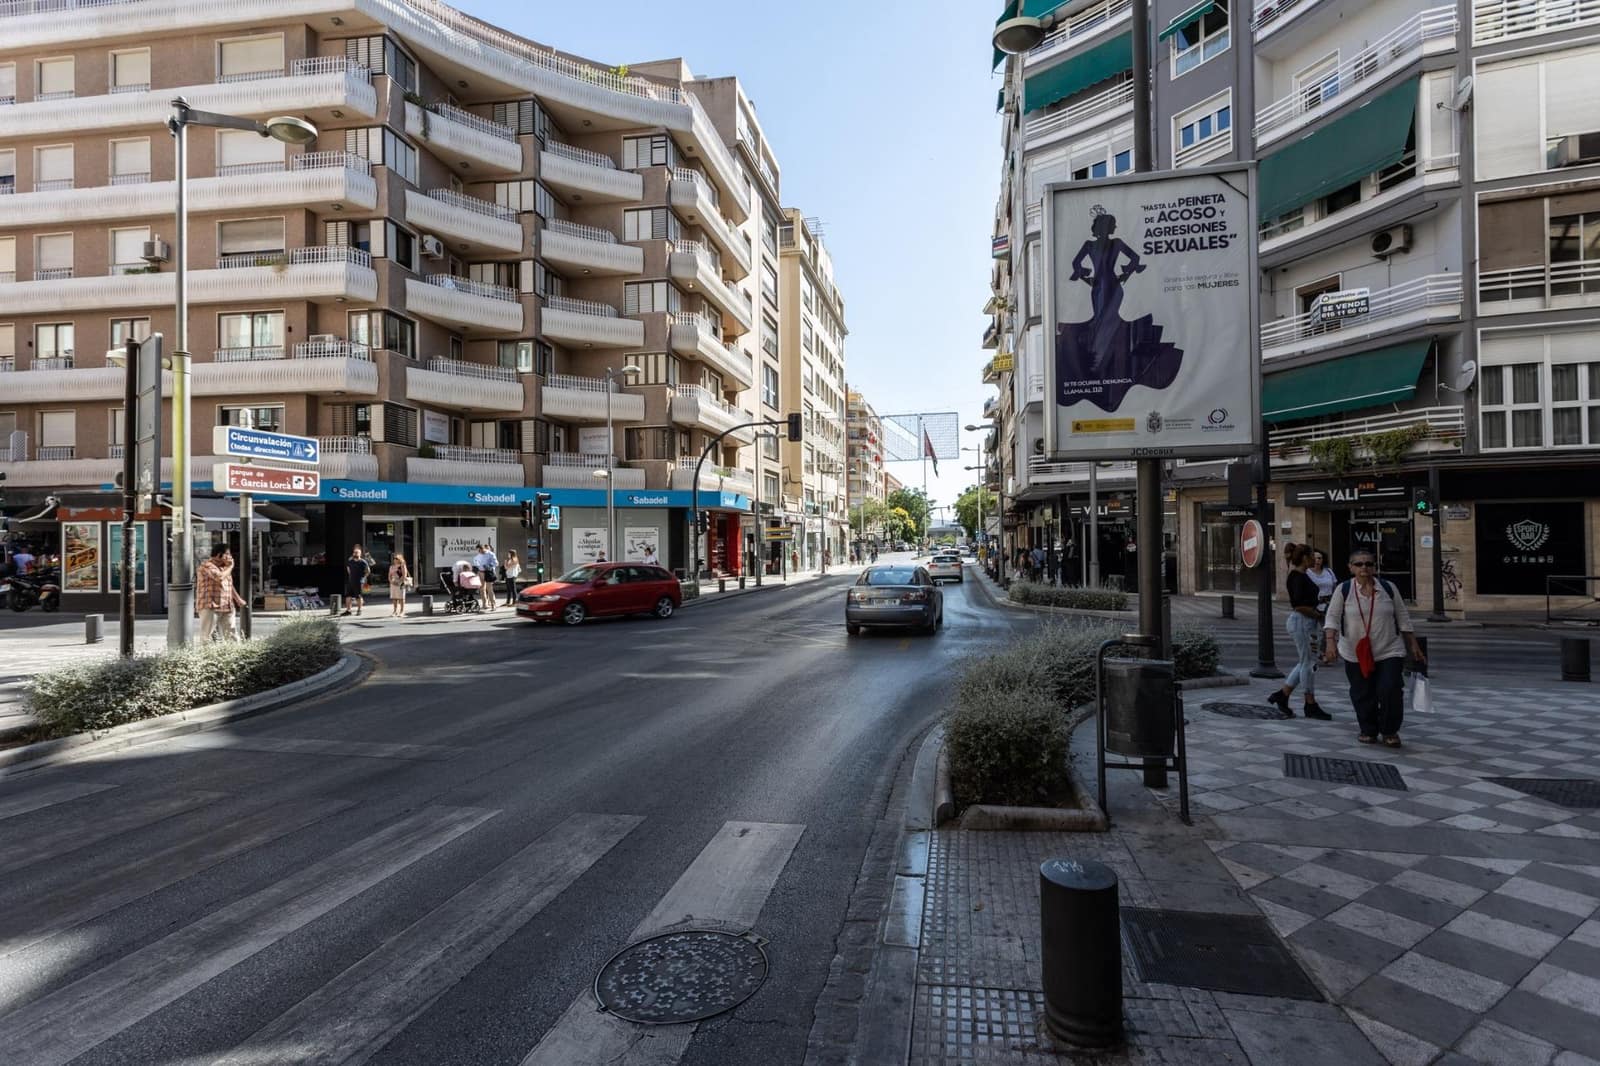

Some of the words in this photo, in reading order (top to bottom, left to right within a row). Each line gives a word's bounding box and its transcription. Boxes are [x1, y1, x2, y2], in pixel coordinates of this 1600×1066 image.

[1178, 193, 1226, 208] PEINETA
[1144, 216, 1155, 224] DE
[1157, 206, 1217, 224] ACOSO
[1219, 209, 1226, 217] Y
[1143, 221, 1228, 239] AGRESIONES
[1197, 279, 1240, 289] MUJERES
[1322, 304, 1334, 313] SE
[1335, 299, 1367, 310] VENDE
[230, 431, 292, 448] Circunvalación
[230, 442, 252, 452] (todas
[254, 445, 290, 457] direcciones)
[1130, 447, 1174, 456] JCDecaux
[230, 469, 254, 477] parque
[231, 477, 240, 487] F.
[270, 480, 291, 490] Lorca
[338, 487, 388, 500] Sabadell
[474, 492, 516, 504] Sabadell
[632, 494, 669, 506] Sabadell
[1327, 487, 1359, 502] VALI
[1083, 505, 1109, 516] VLI
[1517, 524, 1539, 534] SPORT
[1354, 530, 1383, 543] VALI
[1520, 532, 1536, 541] BAR
